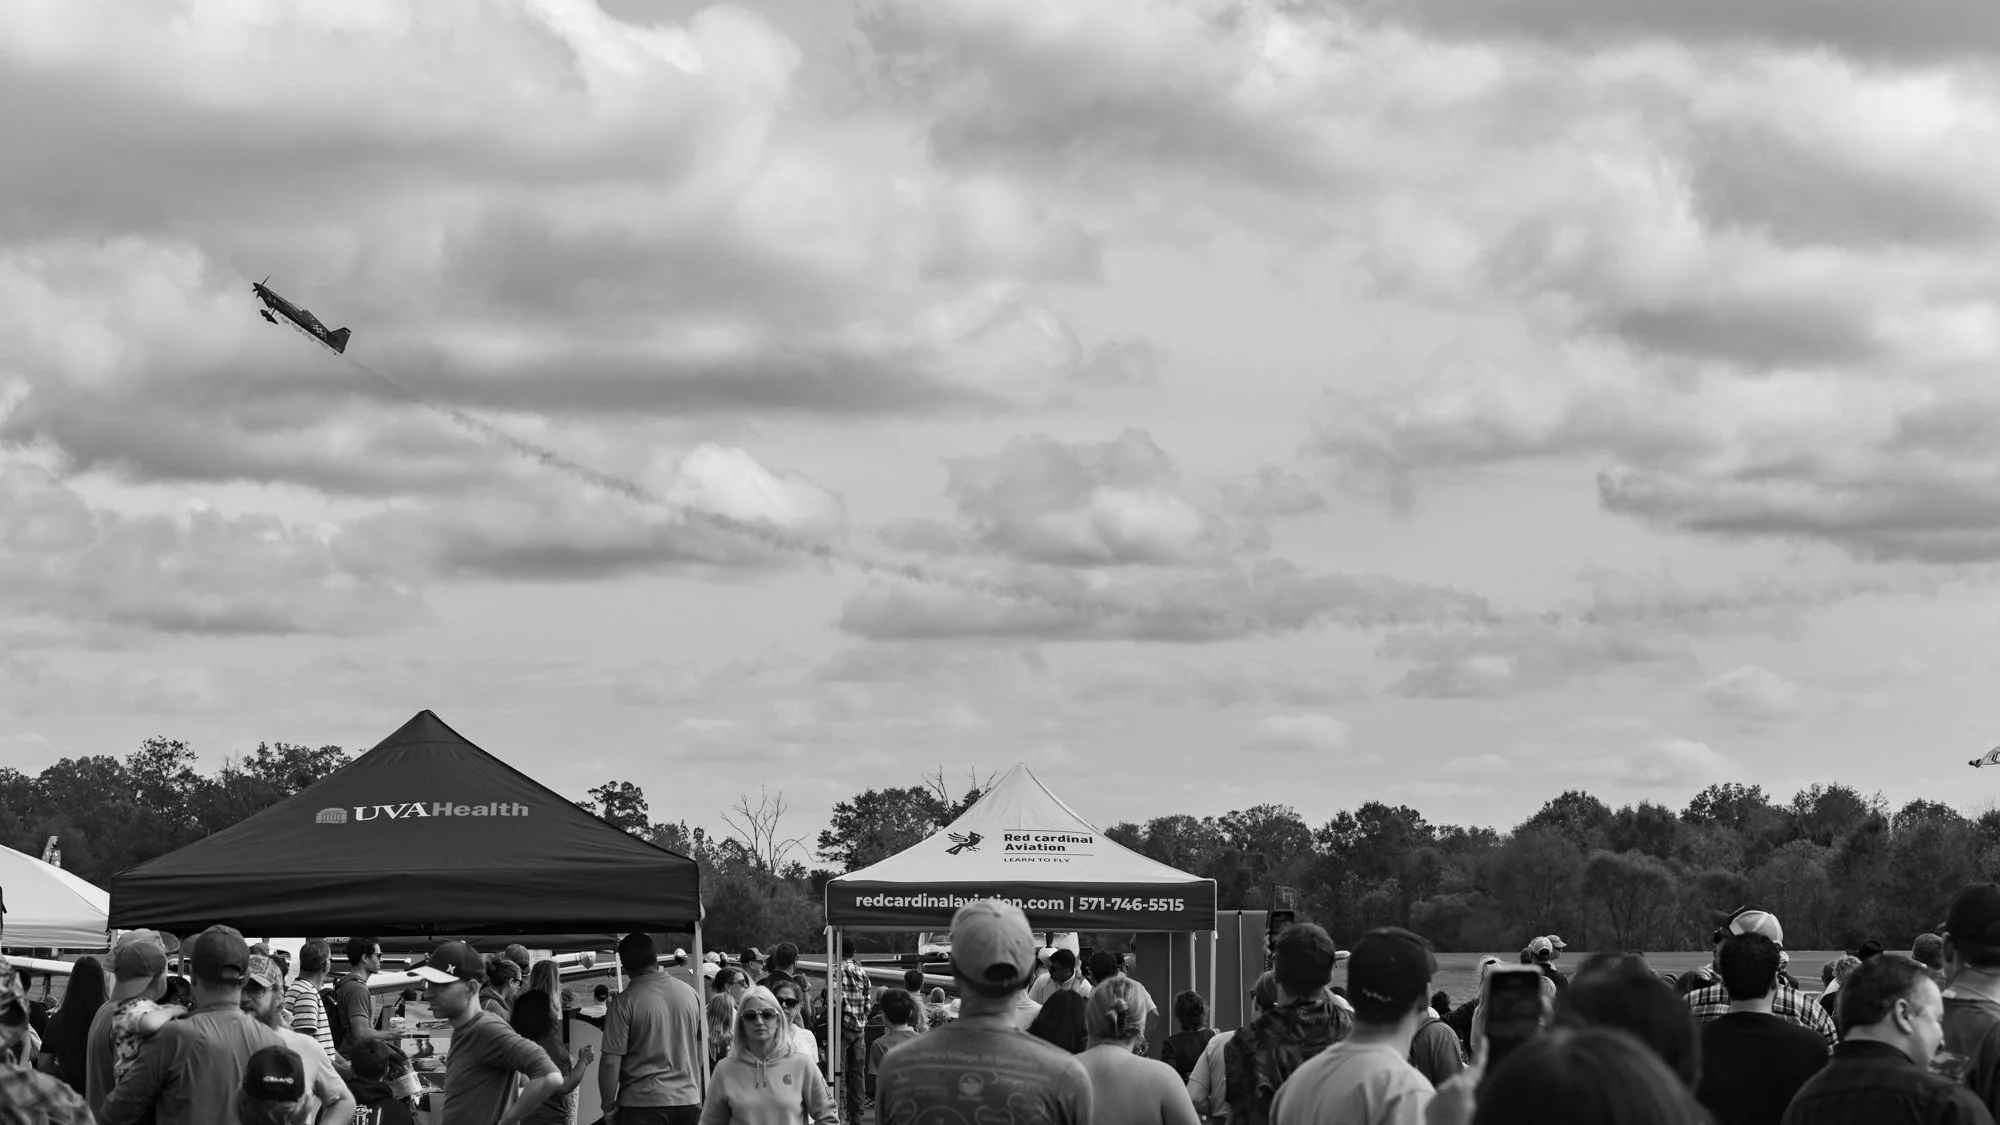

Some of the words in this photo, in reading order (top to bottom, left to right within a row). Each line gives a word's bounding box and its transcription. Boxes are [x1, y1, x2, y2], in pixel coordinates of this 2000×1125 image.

[353, 802, 431, 821] UVA
[432, 802, 529, 817] Health
[1004, 833, 1030, 842] Red
[1034, 834, 1093, 844] cardinal
[1004, 843, 1066, 852] Aviation
[855, 893, 1065, 910] redcardinalaviion.com
[1078, 896, 1185, 912] 571-746-5515
